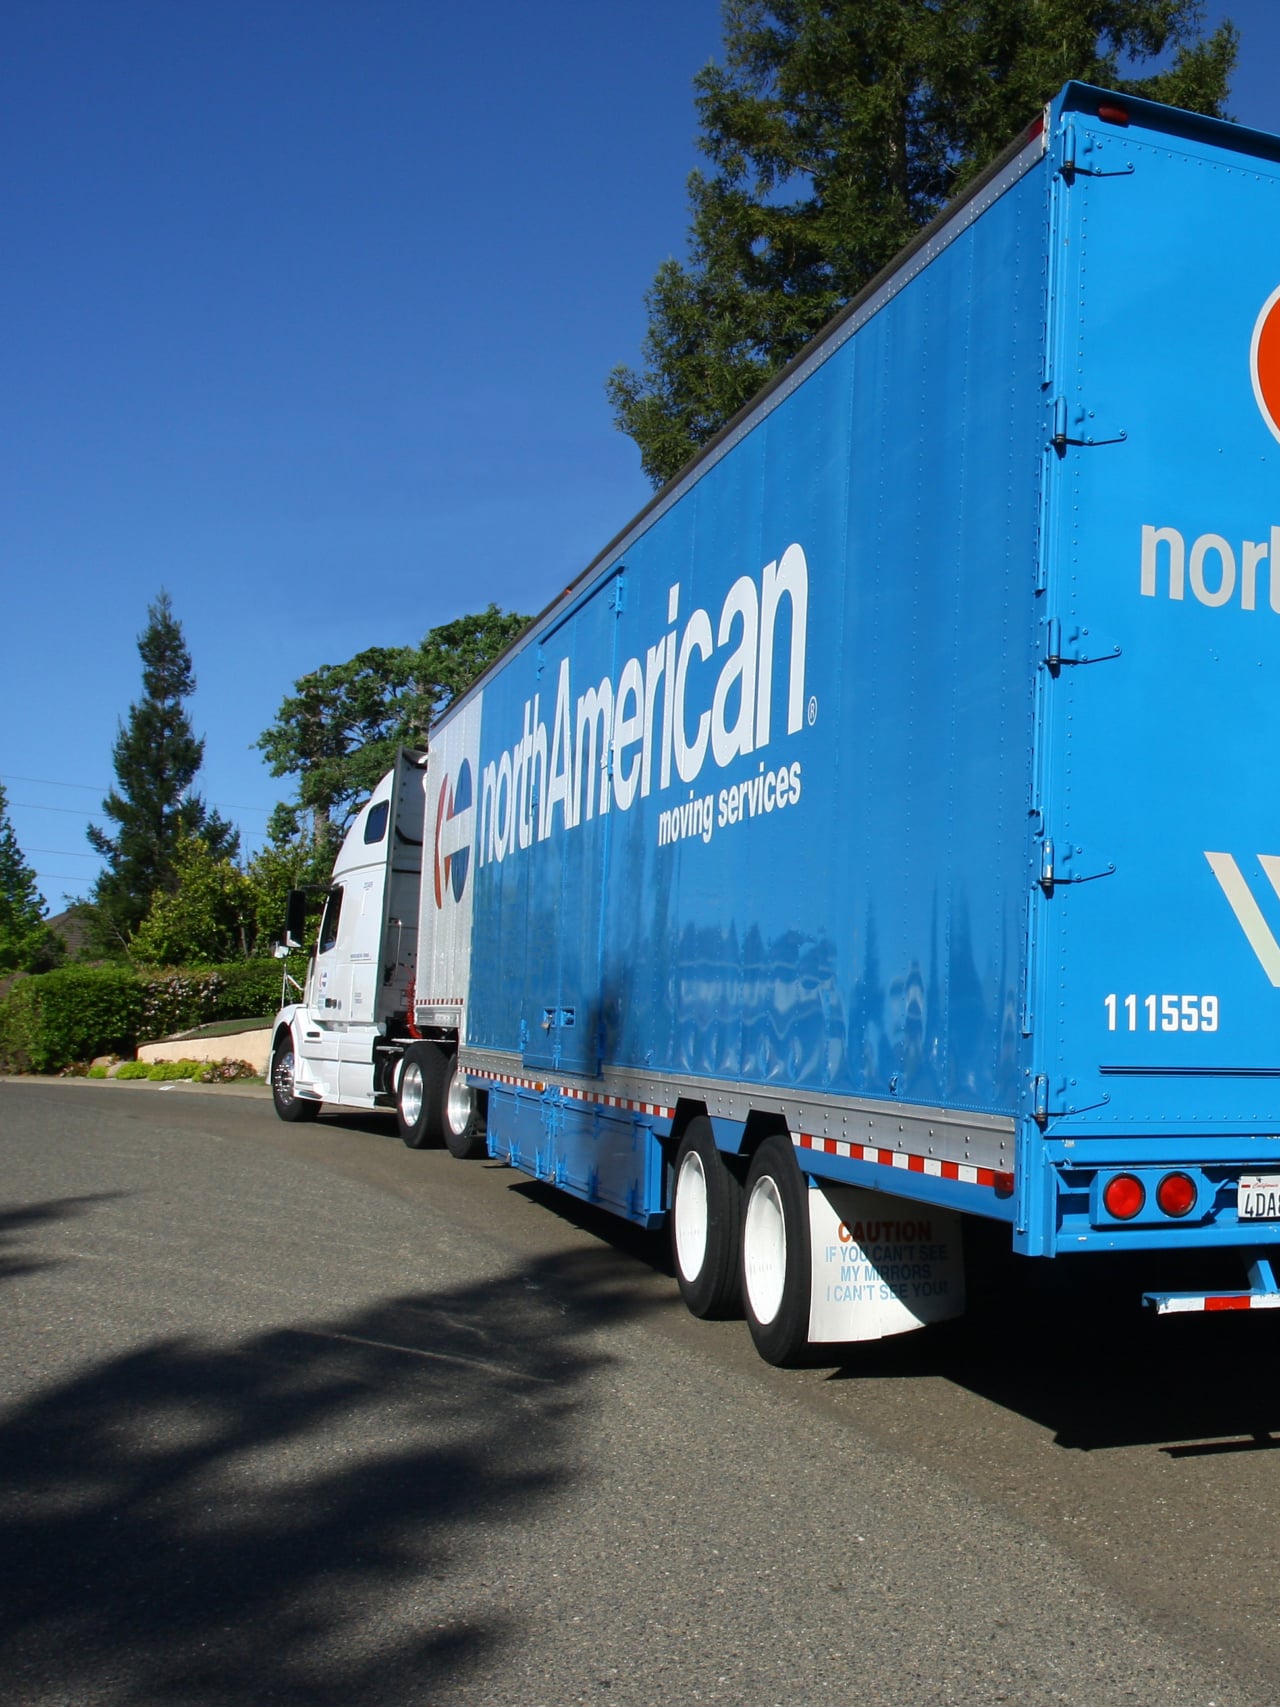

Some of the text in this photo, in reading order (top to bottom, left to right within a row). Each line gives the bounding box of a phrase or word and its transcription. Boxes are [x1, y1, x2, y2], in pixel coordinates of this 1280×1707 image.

[658, 761, 802, 847] moving services
[1104, 993, 1219, 1032] 111559
[838, 1221, 932, 1243] CAUTION
[826, 1244, 947, 1262] IF YOU CAN'T SEE
[840, 1264, 932, 1282] MY MIRRORS
[827, 1285, 831, 1301] I
[834, 1284, 875, 1302] CAN'T
[879, 1282, 907, 1300] SEE
